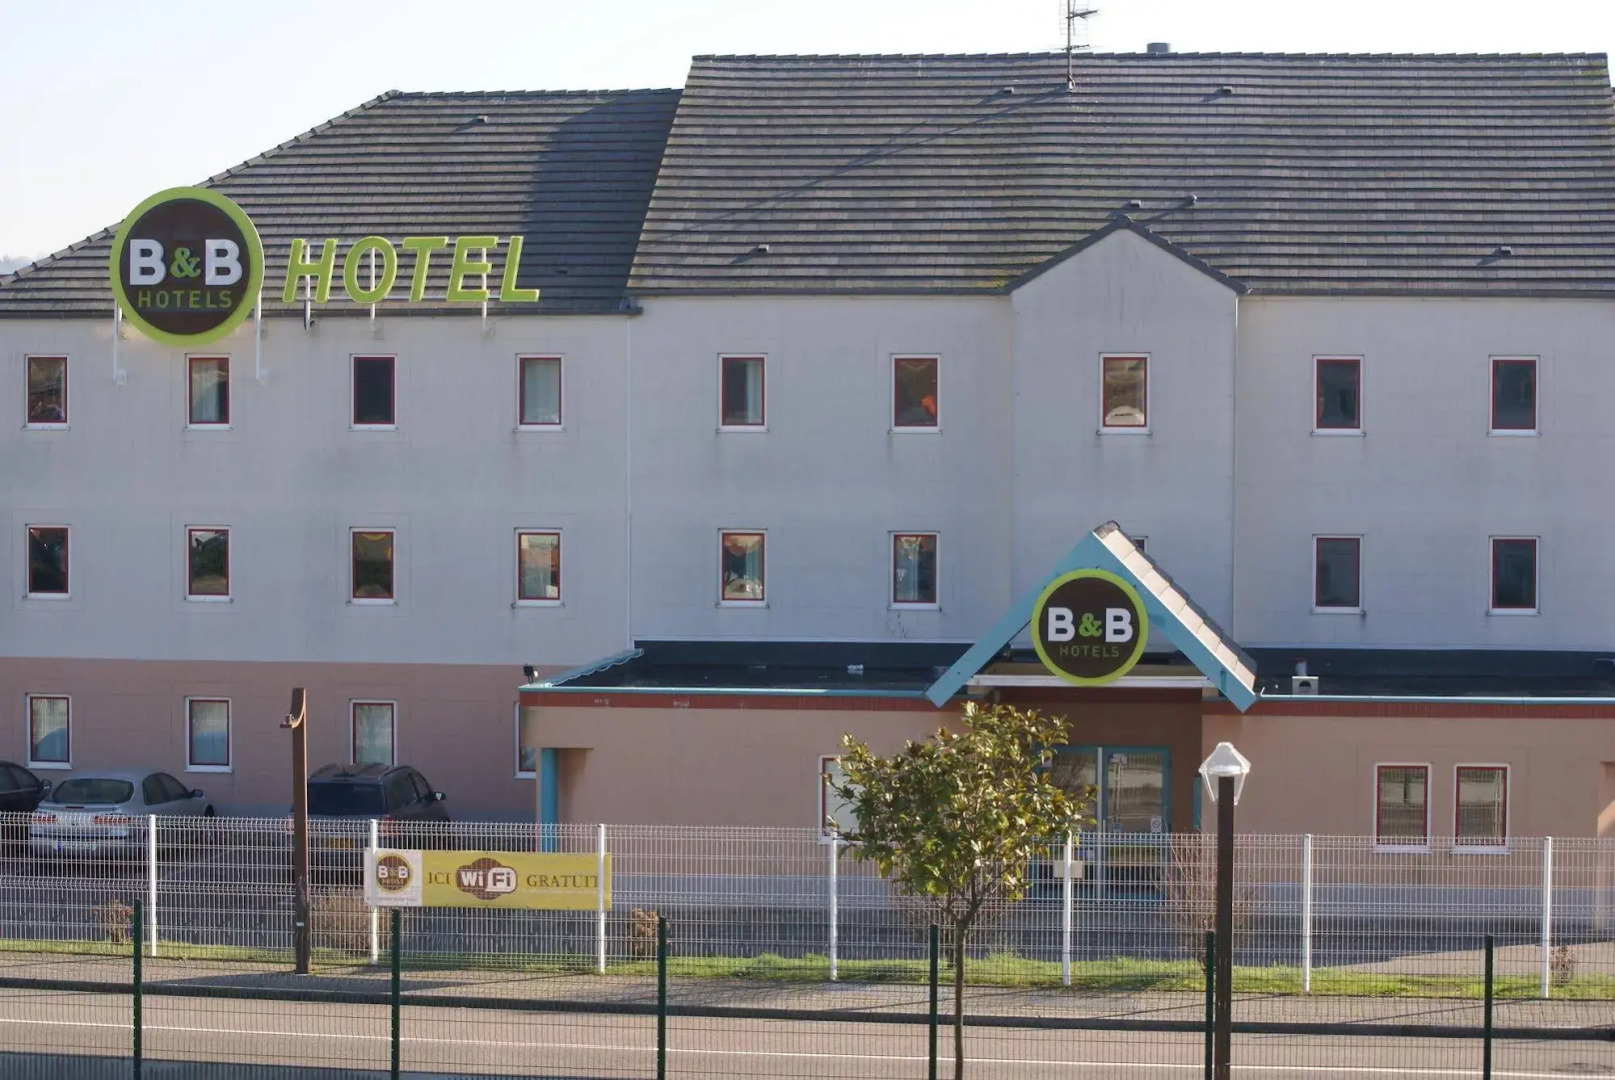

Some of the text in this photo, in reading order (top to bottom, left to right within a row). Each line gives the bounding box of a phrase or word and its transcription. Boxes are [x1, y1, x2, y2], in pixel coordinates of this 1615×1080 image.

[129, 238, 243, 286] B&B
[282, 235, 540, 304] HOTEL
[138, 290, 233, 309] HOTELS
[1047, 607, 1134, 643] B&B
[1059, 645, 1120, 658] HOTELS
[378, 865, 409, 879] B&B
[428, 871, 451, 885] ICI
[526, 874, 599, 888] GRATUIT
